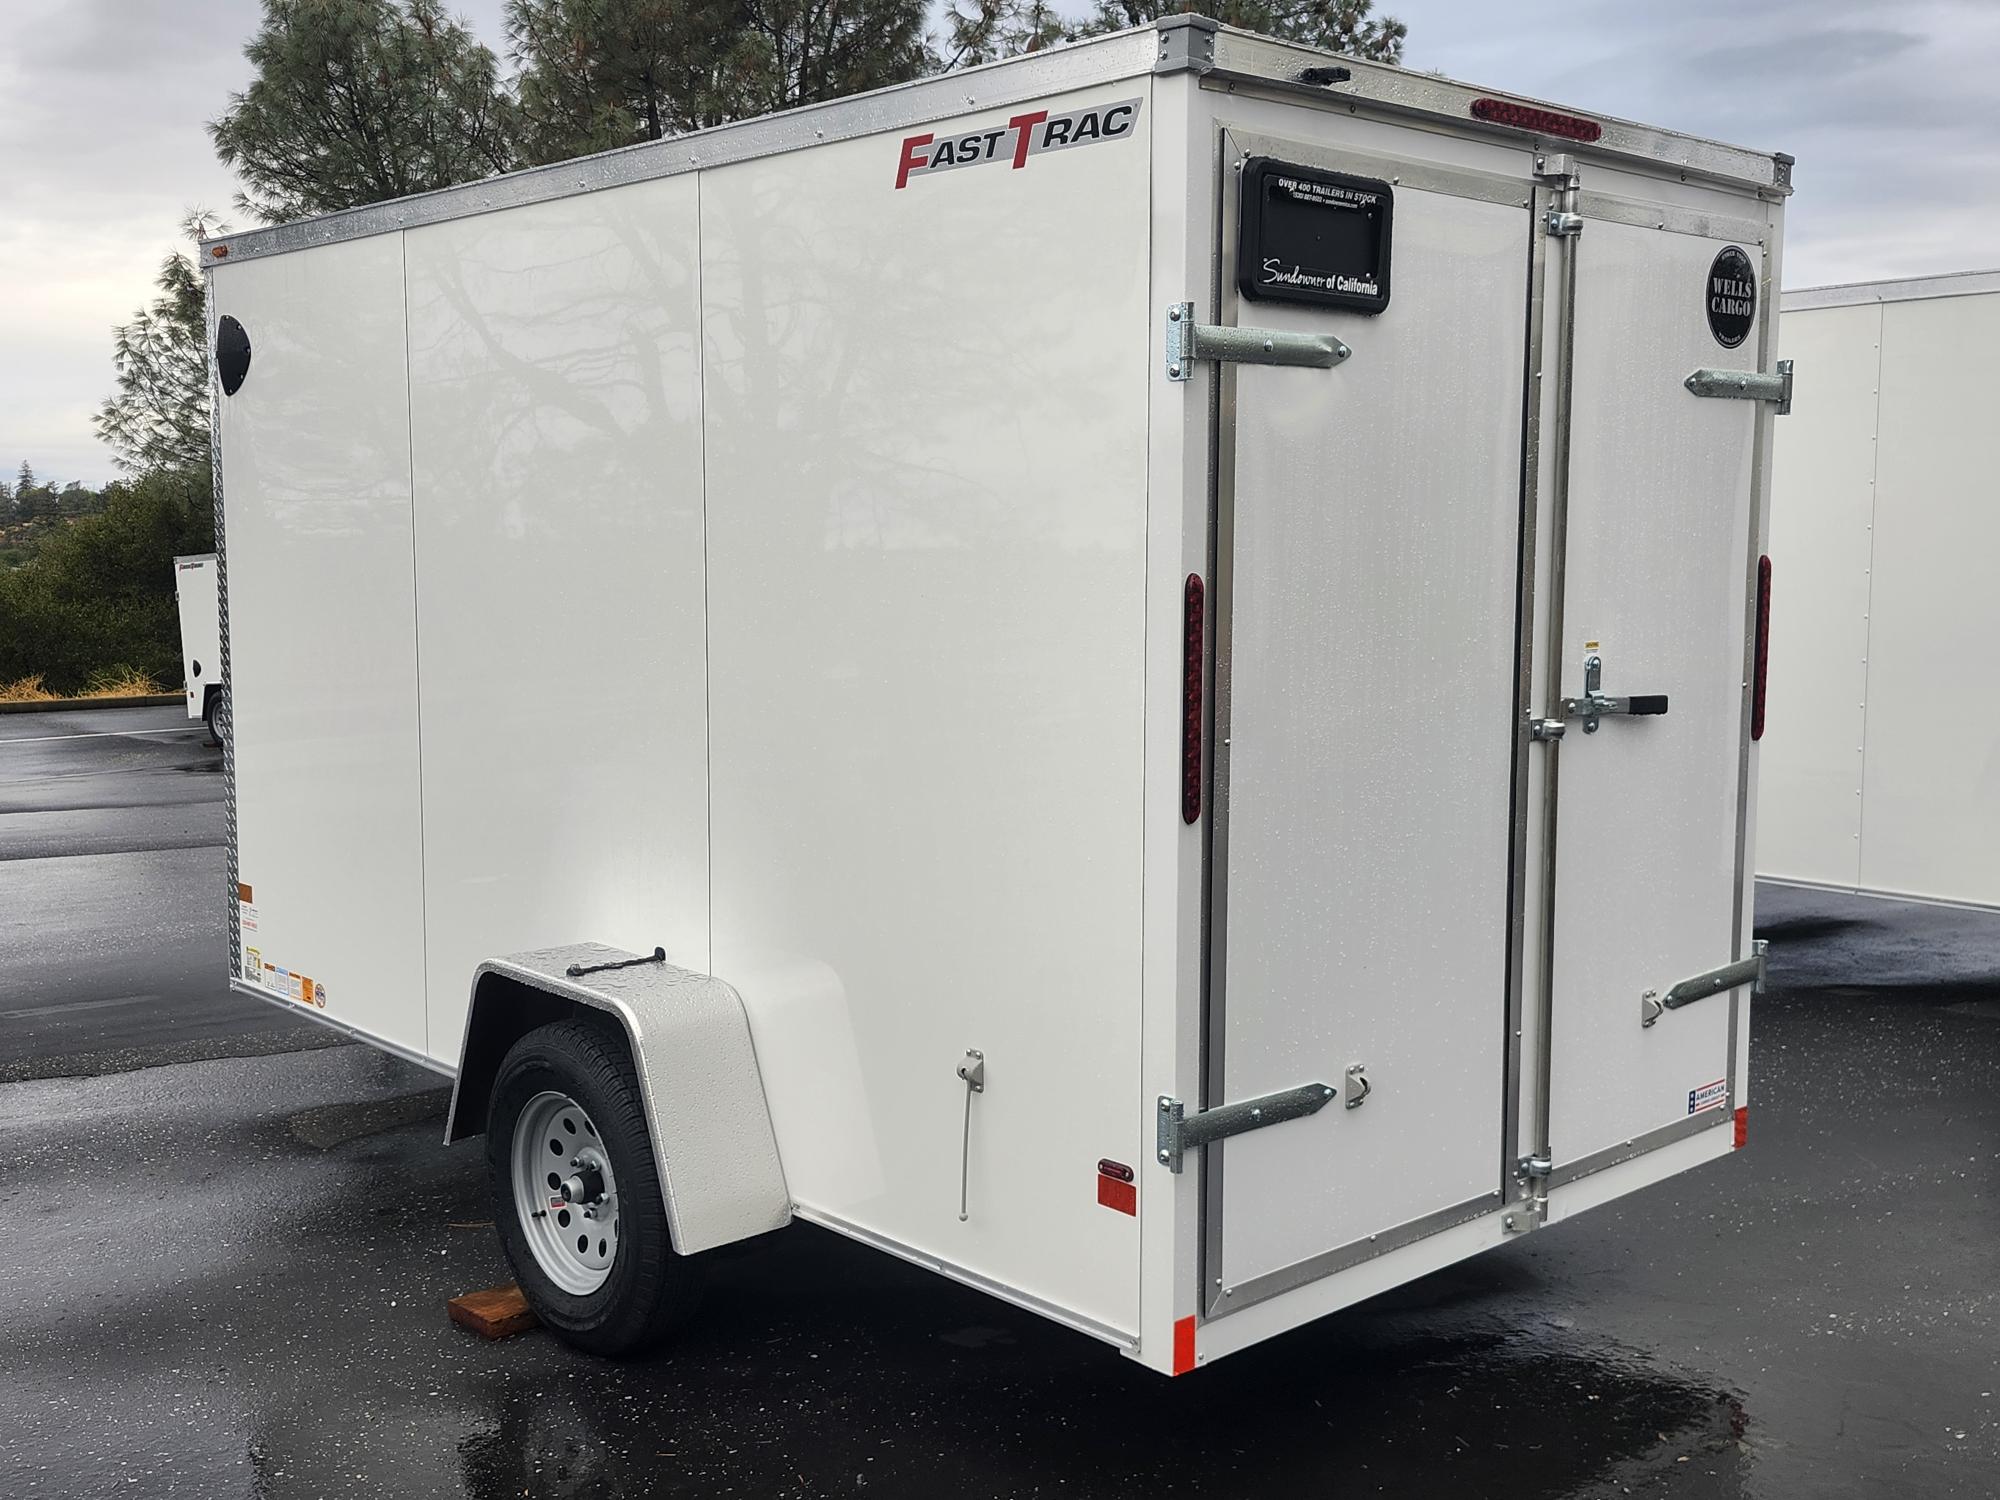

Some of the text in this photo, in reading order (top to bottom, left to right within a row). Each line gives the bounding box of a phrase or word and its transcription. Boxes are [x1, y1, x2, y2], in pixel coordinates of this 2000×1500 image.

[1278, 178, 1298, 190] OVER
[1298, 183, 1311, 192] 400
[1312, 185, 1345, 199] TRAILERS
[1345, 191, 1354, 200] IN
[1354, 192, 1377, 204] STOCK
[1263, 258, 1378, 296] Sundowner of California
[1713, 277, 1752, 298] WELLS
[1711, 296, 1751, 317] CARGO
[1696, 1084, 1725, 1100] AMERICAN
